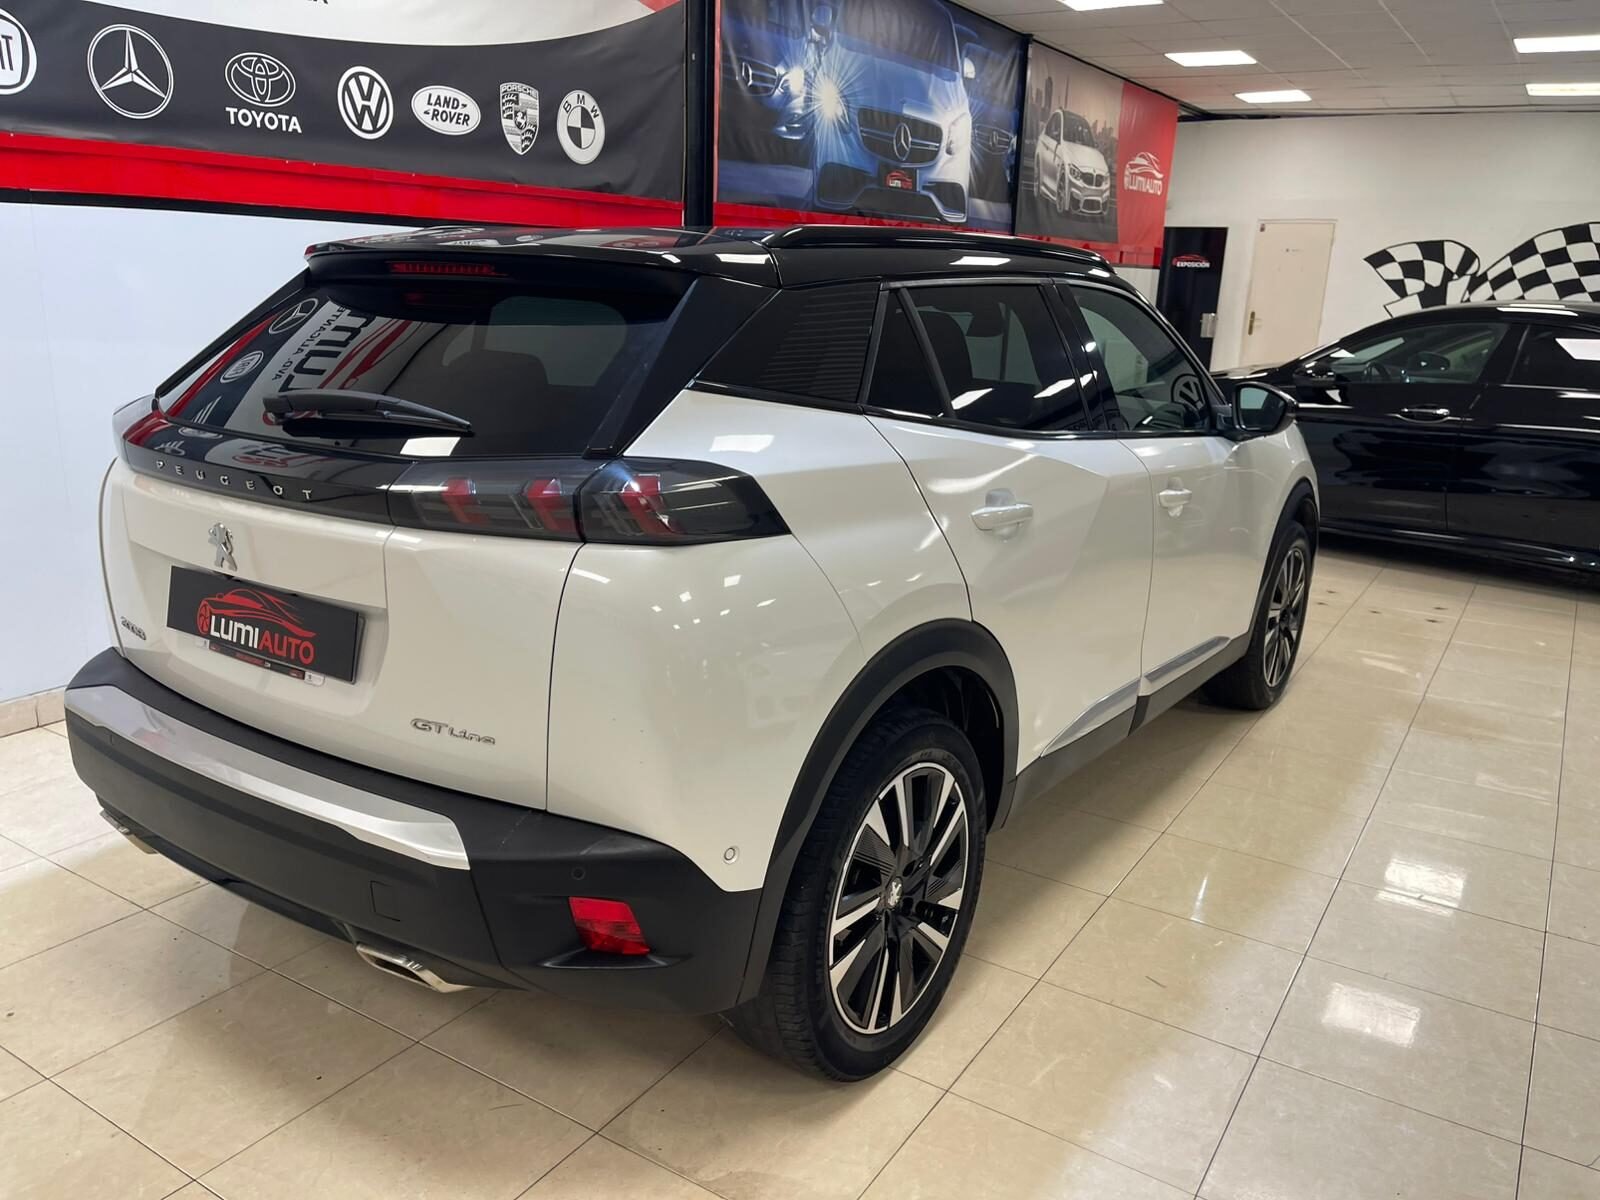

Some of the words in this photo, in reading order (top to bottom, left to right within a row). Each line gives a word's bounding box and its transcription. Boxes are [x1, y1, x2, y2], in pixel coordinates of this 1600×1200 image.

[426, 92, 459, 110] LAND
[563, 93, 601, 120] BMW
[225, 106, 303, 134] TOYOTA
[430, 109, 471, 127] ROVER
[156, 460, 312, 500] PEUGEOT
[209, 614, 316, 666] LUMIAUTO
[410, 717, 449, 734] GT
